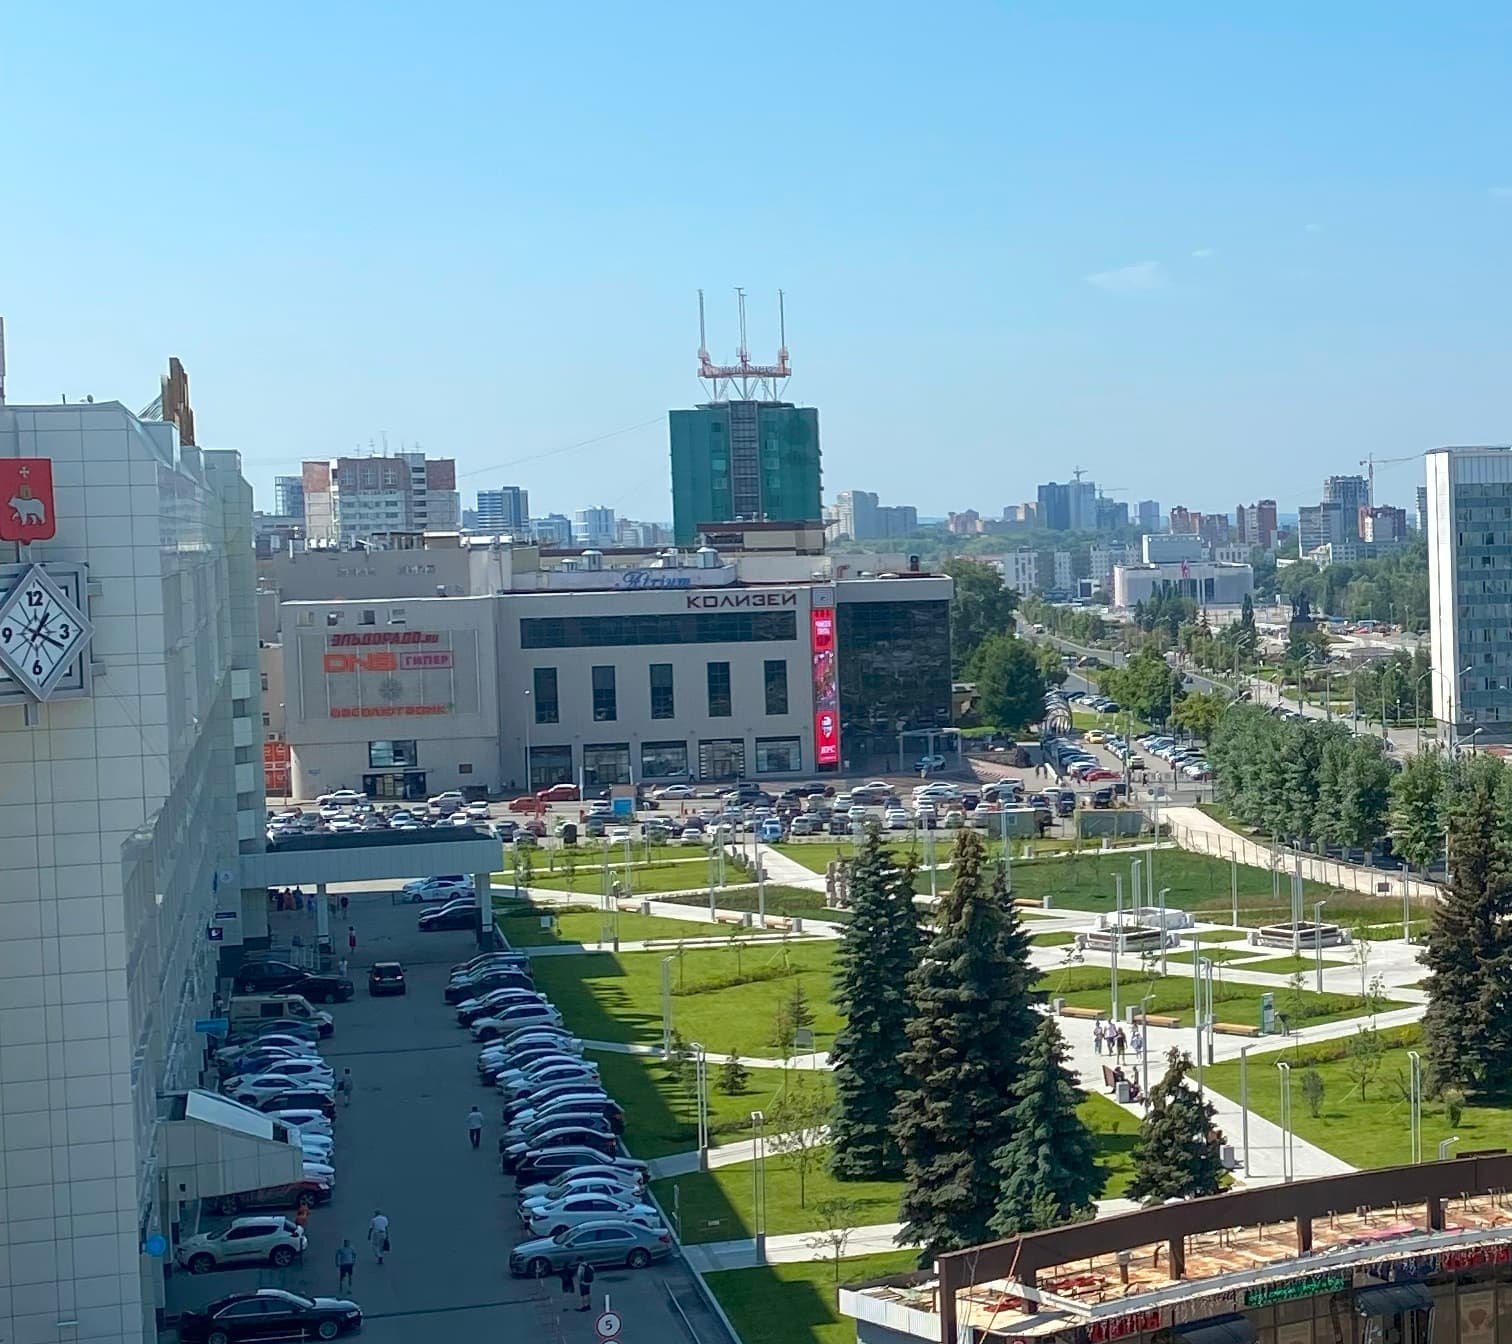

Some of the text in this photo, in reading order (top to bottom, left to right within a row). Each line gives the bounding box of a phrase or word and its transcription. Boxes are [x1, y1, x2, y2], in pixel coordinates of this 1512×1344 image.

[26, 591, 43, 606] 12
[687, 591, 797, 608] КОЛИЗЕЙ
[2, 627, 12, 643] 9
[59, 624, 70, 639] 3
[32, 660, 43, 675] 6
[324, 652, 397, 673] DNS
[406, 654, 449, 666] ГИПЕР
[605, 1319, 613, 1331] 5
